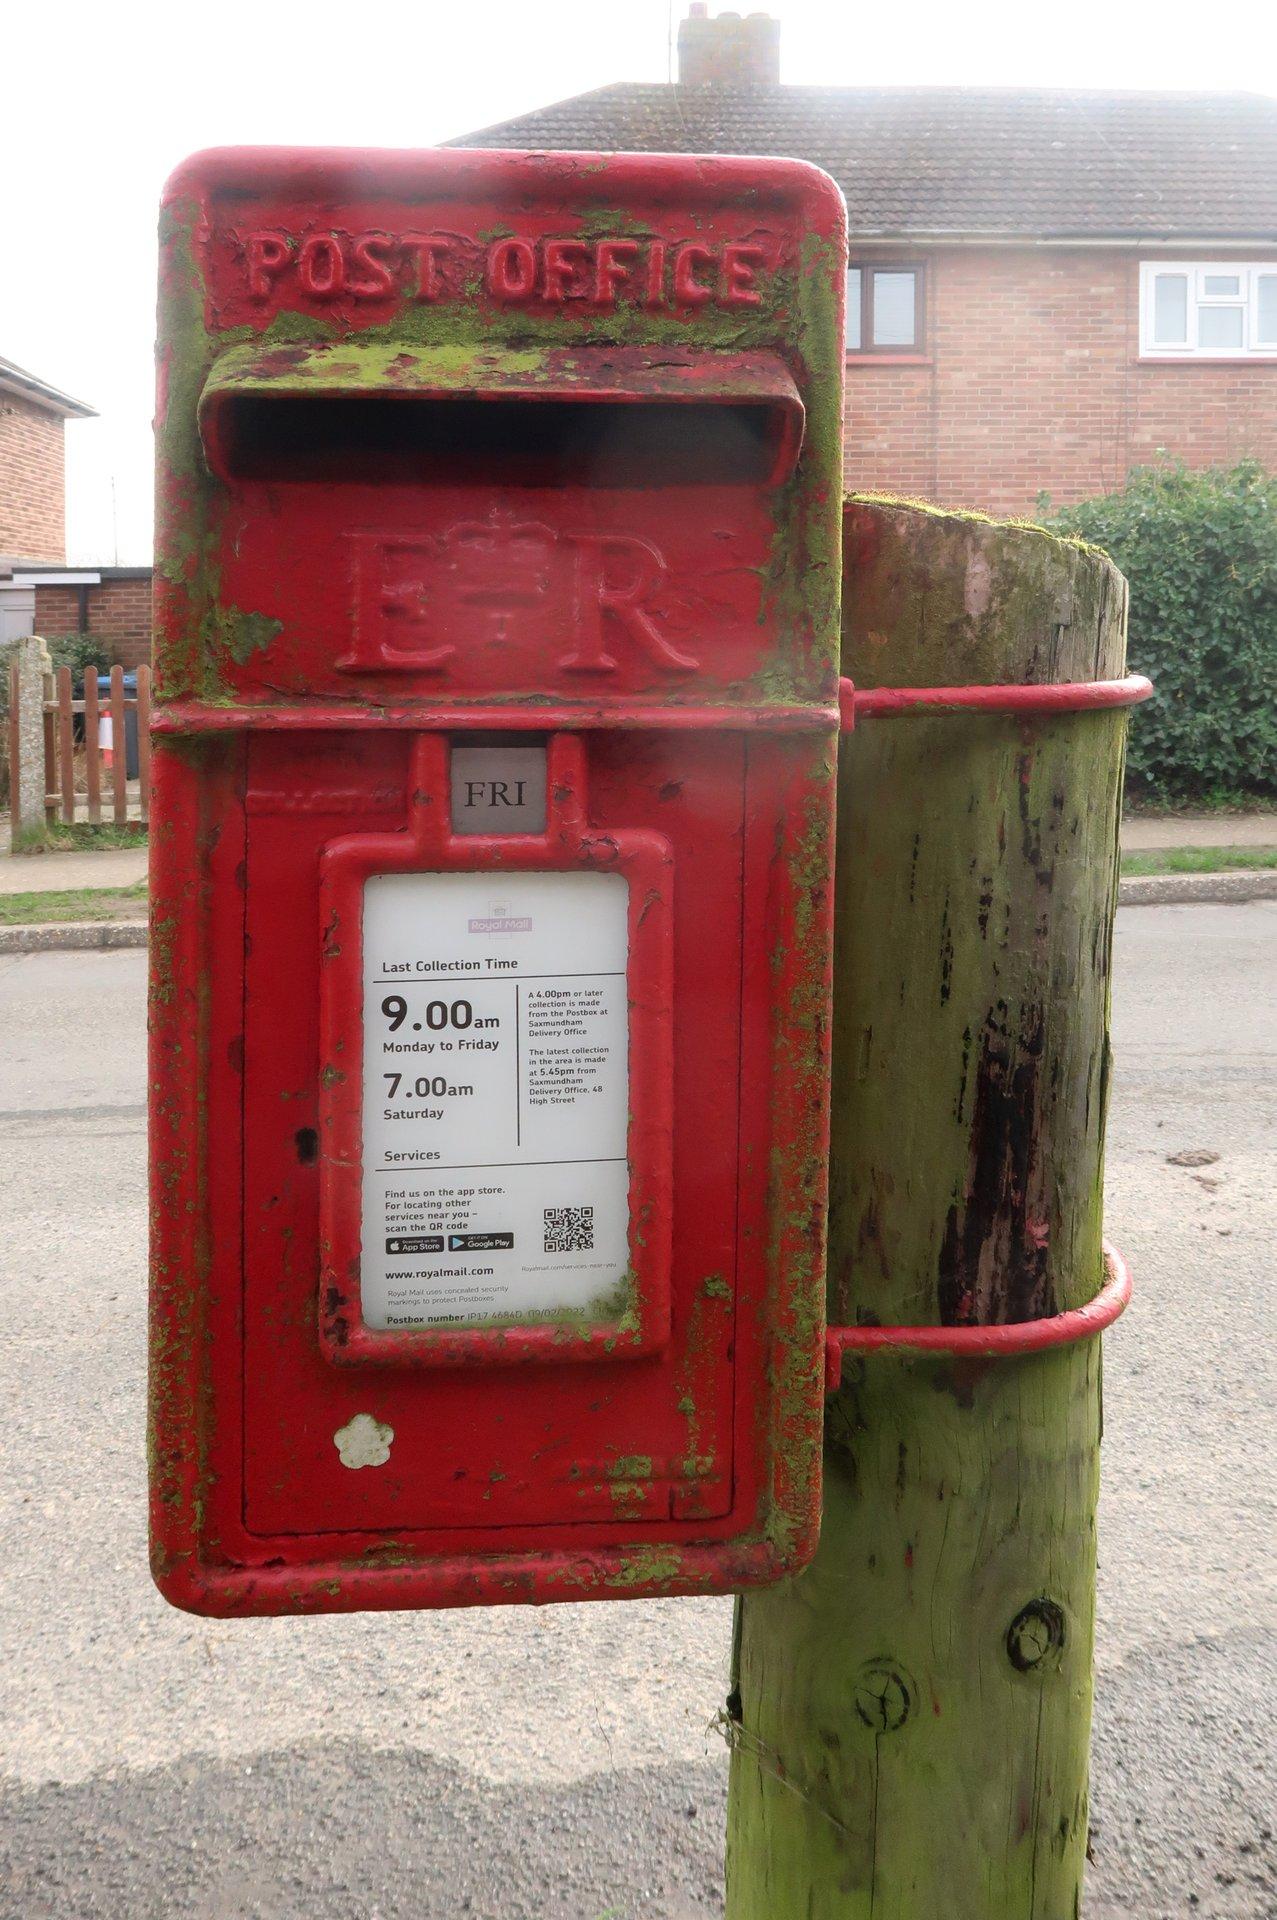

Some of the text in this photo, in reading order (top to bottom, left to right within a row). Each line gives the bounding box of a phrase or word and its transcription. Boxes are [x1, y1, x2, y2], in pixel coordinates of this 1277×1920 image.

[246, 231, 764, 305] POST OFFICE
[464, 779, 527, 808] FRI
[472, 920, 528, 931] Royal Mail
[382, 959, 518, 973] Last Collection Time
[537, 990, 571, 999] 4.00pm
[585, 989, 603, 997] later
[381, 995, 500, 1031] 9.00am
[567, 1008, 597, 1016] Postbox
[529, 1018, 582, 1027] Saxmundham
[529, 1027, 587, 1037] Delivery Office
[384, 1039, 499, 1053] Monday to Friday
[572, 1046, 609, 1054] collection
[540, 1067, 575, 1076] 5.45pm
[383, 1073, 473, 1098] 7.00am
[530, 1077, 583, 1085] Saxmundham
[530, 1087, 562, 1096] Delivery
[530, 1097, 548, 1105] High
[384, 1108, 444, 1120] Saturday
[384, 1150, 440, 1161] Services
[385, 1190, 405, 1198] Find
[439, 1188, 454, 1196] the
[458, 1188, 475, 1196] app
[478, 1186, 505, 1194] store.
[385, 1199, 471, 1210] For locating other
[385, 1213, 424, 1221] services
[411, 1223, 426, 1231] the
[430, 1222, 443, 1230] QR
[447, 1221, 468, 1229] code
[385, 1266, 494, 1280] www.royalmail.com
[388, 1289, 407, 1297] Royal
[444, 1287, 479, 1295] concealed
[481, 1286, 509, 1294] security
[388, 1298, 421, 1306] markings
[432, 1296, 456, 1305] protect
[387, 1316, 424, 1324] Postbox
[428, 1314, 464, 1323] number
[468, 1312, 487, 1321] IP17
